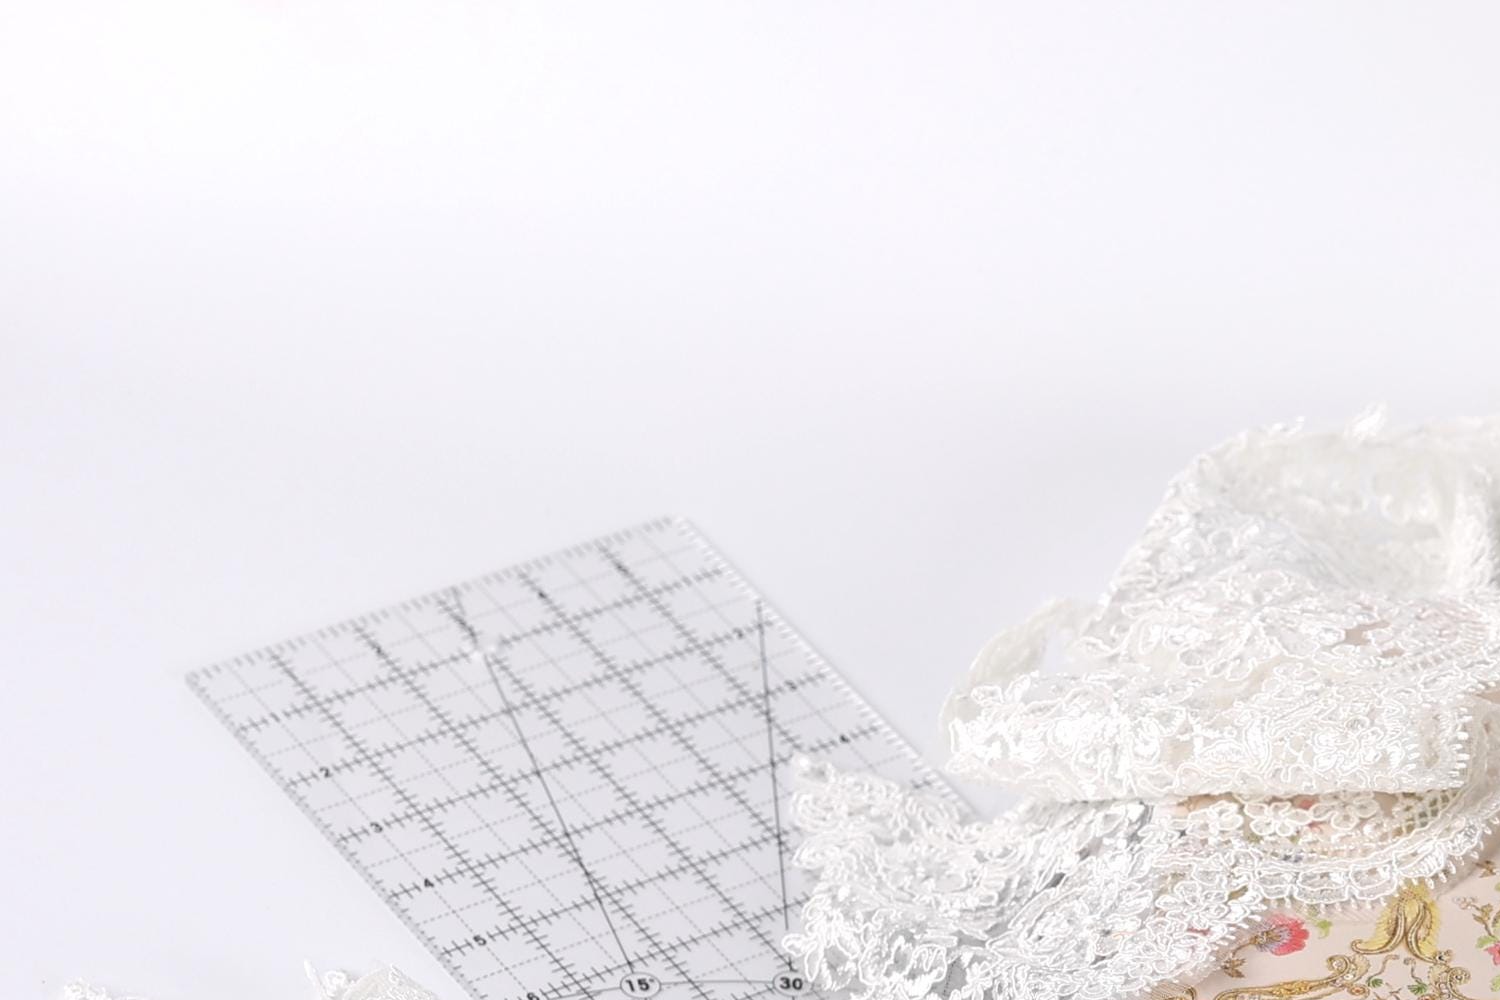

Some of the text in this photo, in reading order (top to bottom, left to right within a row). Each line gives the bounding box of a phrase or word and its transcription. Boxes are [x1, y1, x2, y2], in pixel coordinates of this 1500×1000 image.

[369, 821, 383, 833] 3
[423, 877, 435, 888] 4
[472, 934, 487, 946] 5
